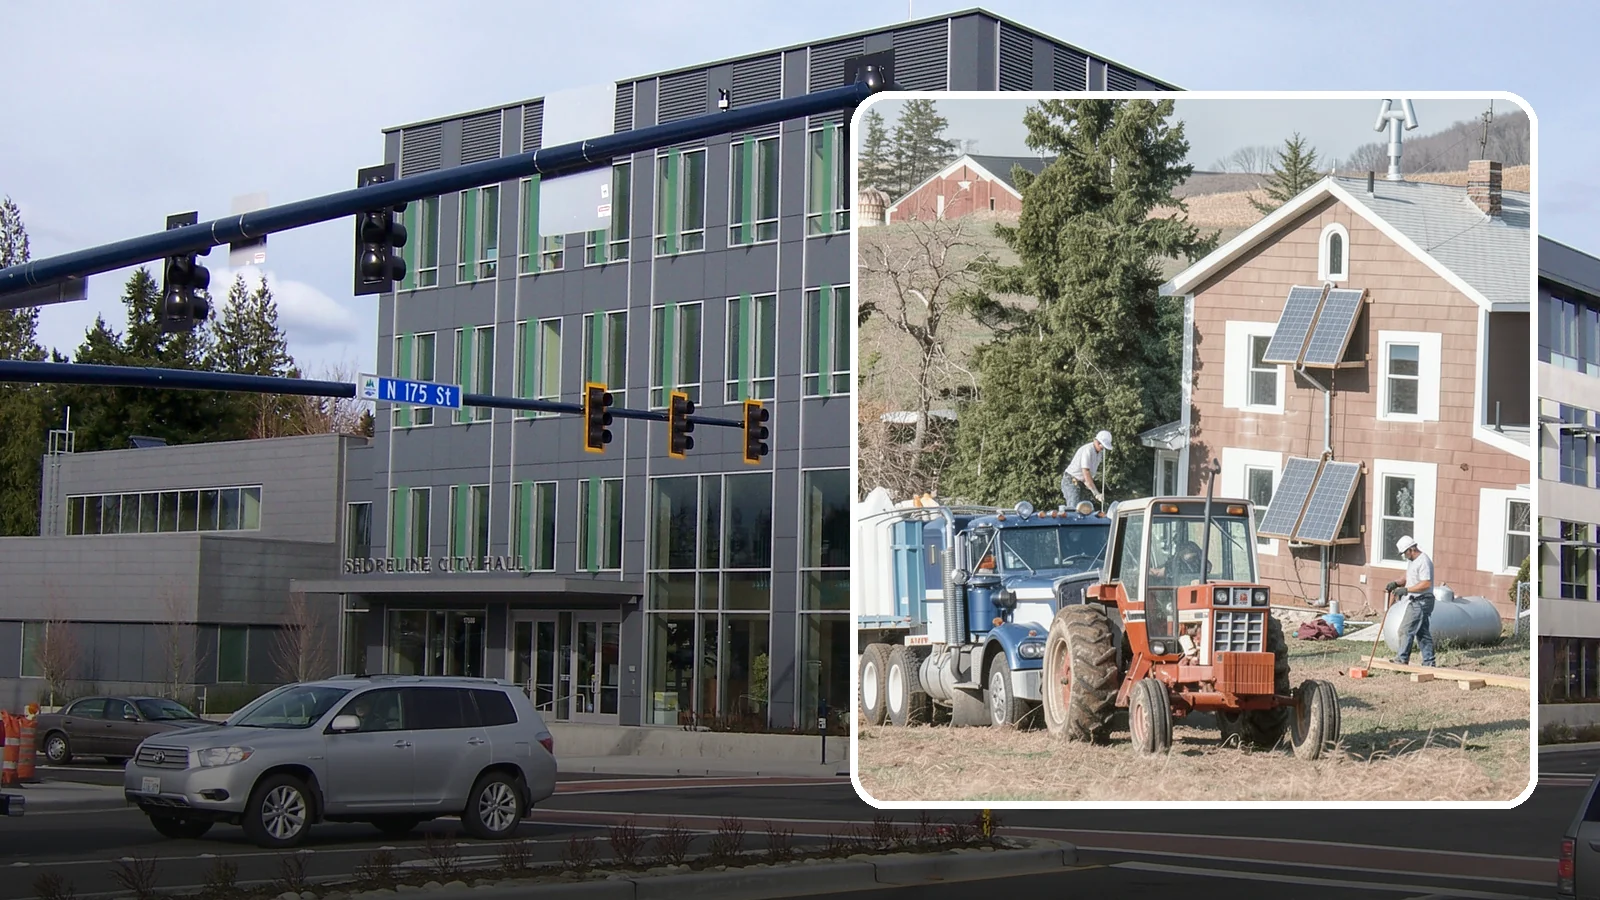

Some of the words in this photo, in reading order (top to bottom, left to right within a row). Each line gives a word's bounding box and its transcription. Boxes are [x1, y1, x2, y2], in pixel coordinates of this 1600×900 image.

[387, 380, 396, 400] N
[405, 382, 427, 403] 175
[436, 386, 451, 406] St
[344, 557, 432, 574] SHORELINE
[438, 556, 475, 572] CITY
[483, 555, 525, 571] HALL
